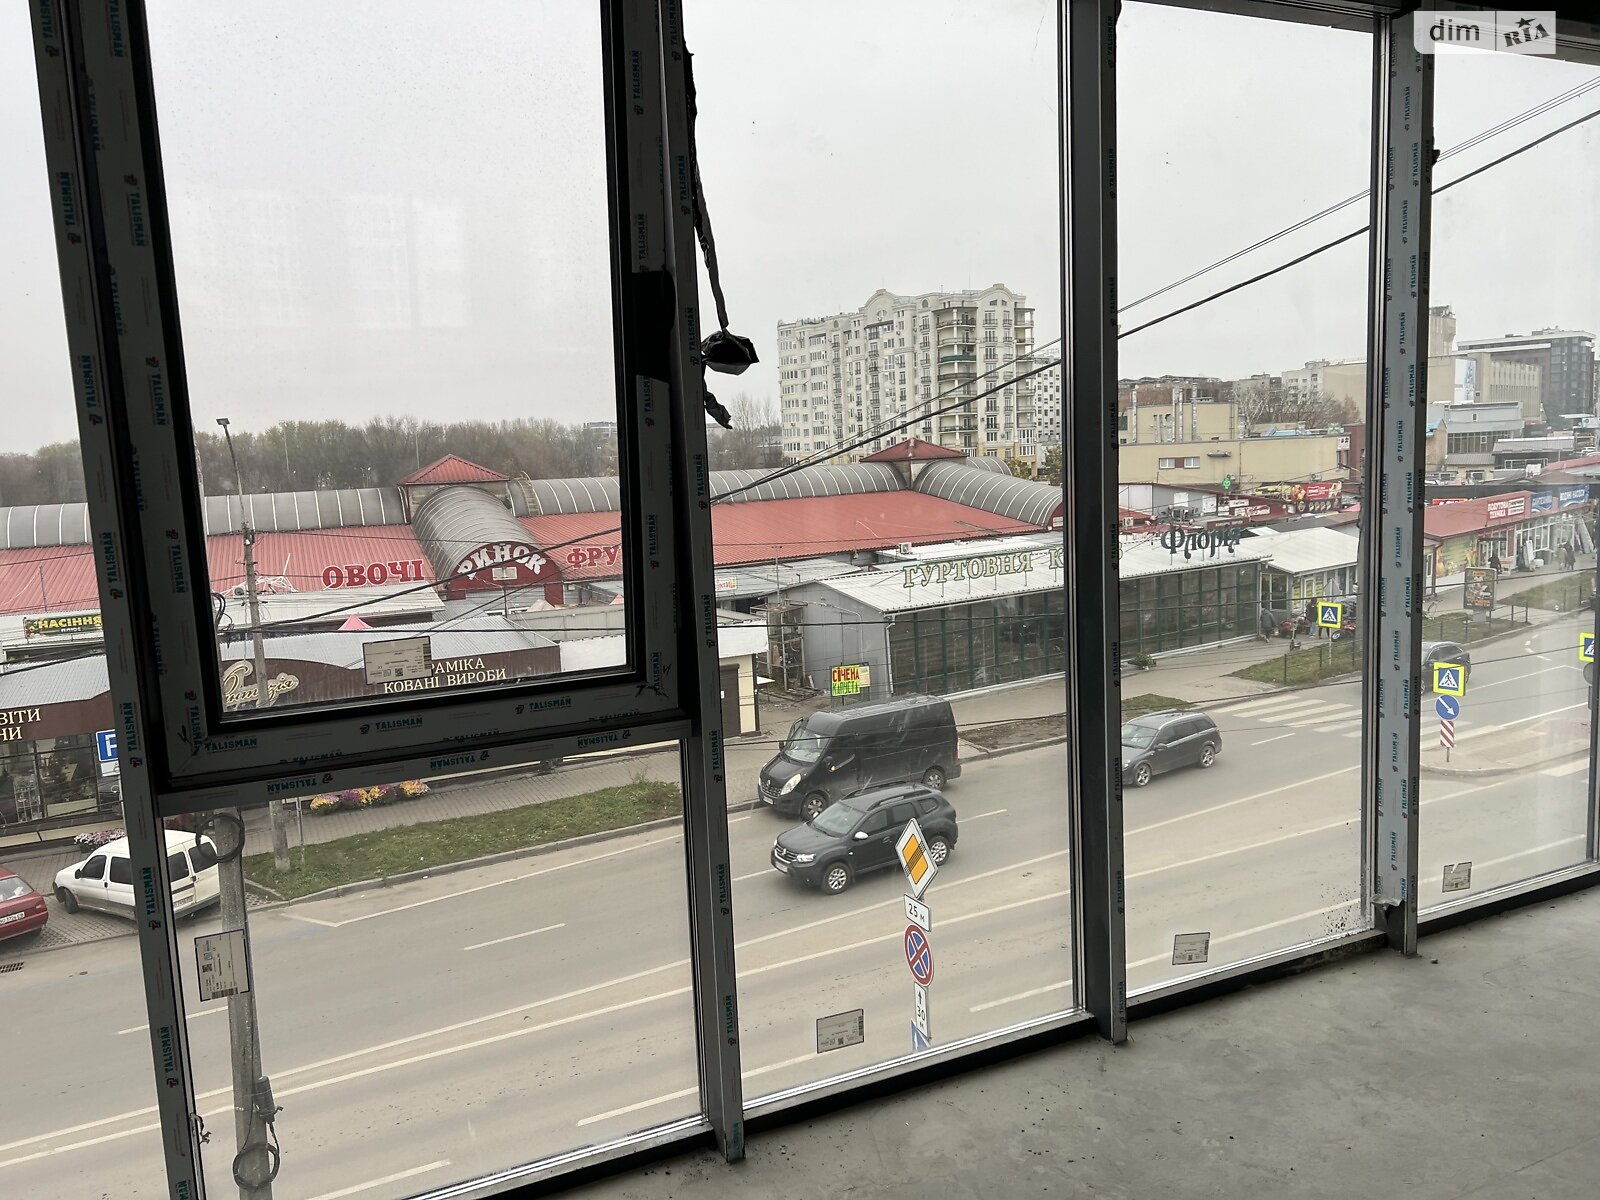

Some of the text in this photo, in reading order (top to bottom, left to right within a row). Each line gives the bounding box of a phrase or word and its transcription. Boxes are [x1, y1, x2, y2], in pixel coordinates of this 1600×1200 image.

[60, 172, 75, 226] TALISMAN
[130, 193, 145, 246] TALISMAN
[81, 355, 97, 408] TALISMAN
[152, 374, 166, 426] TALISMAN
[103, 532, 118, 583] TALISMAN
[171, 544, 185, 593] TALISMAN
[322, 559, 425, 590] ОВОЧІ
[456, 543, 548, 580] РИНОК
[903, 552, 1033, 587] ГУРТОВНЯ
[38, 615, 101, 628] НАСІННЯ
[703, 594, 712, 635] TALISMAN
[384, 669, 507, 694] КОВАНІ ВИРОБИ
[529, 699, 571, 710] TALISMAN
[123, 702, 137, 752] TALISMAN
[375, 717, 423, 730] TALISMAN
[577, 734, 618, 746] TALISMAN
[430, 755, 475, 769] TALISMAN
[710, 730, 720, 770] TALISMAN
[267, 778, 317, 792] TALISMAN
[143, 867, 156, 915] TALISMAN
[908, 902, 919, 918] 25
[917, 1005, 926, 1022] 30
[160, 1026, 174, 1073] TALISMAN
